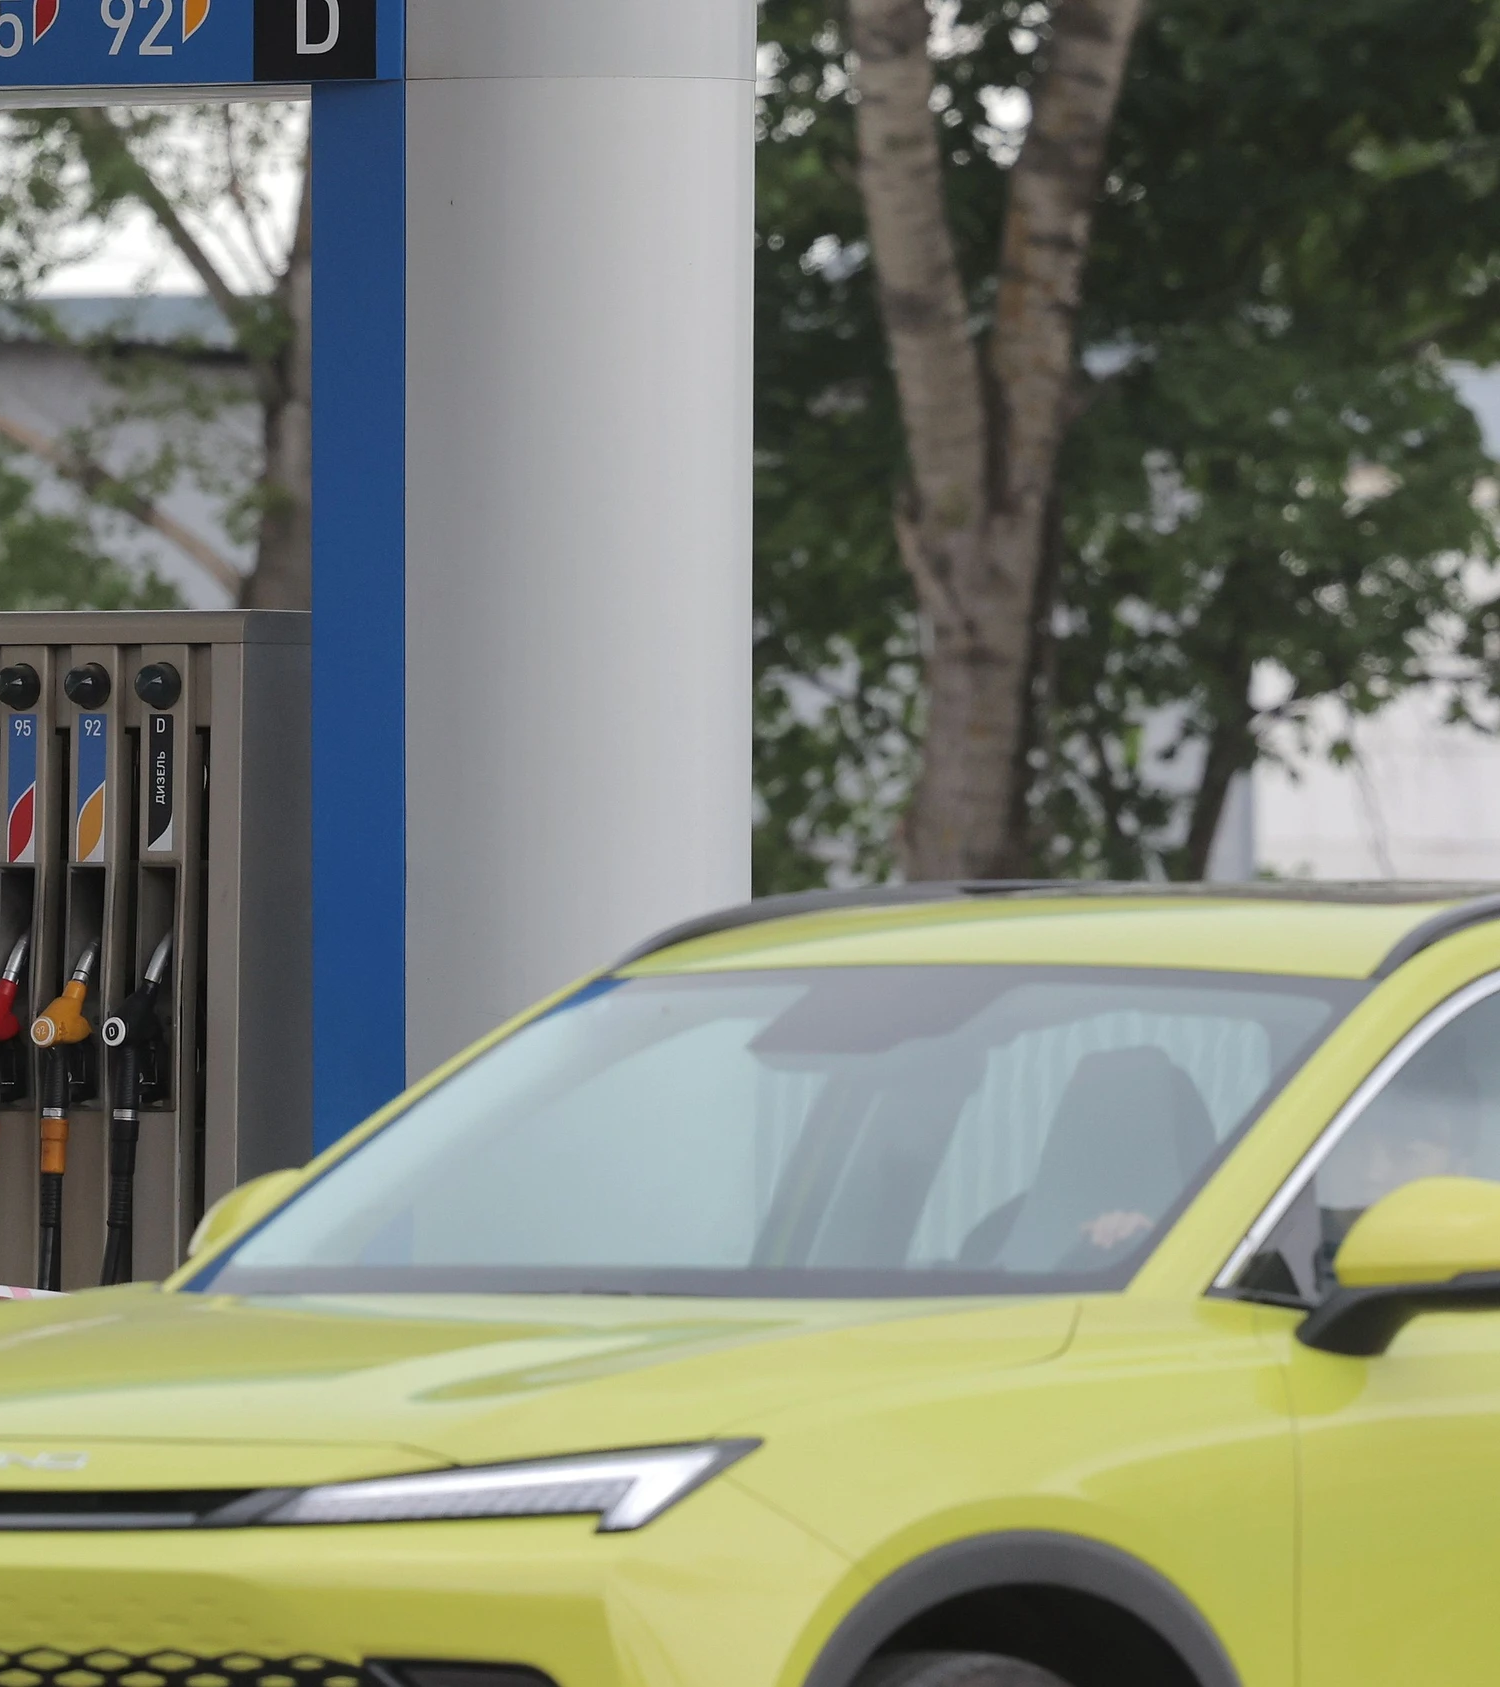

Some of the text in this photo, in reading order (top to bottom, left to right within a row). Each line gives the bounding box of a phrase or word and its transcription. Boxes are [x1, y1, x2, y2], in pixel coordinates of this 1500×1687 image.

[101, 0, 173, 55] 92
[296, 0, 340, 55] D
[14, 720, 31, 736] 95
[84, 720, 101, 736] 92
[156, 718, 166, 733] D
[155, 751, 166, 804] ДИЗЕЛЬ
[36, 1026, 46, 1036] 92
[108, 1027, 115, 1037] D
